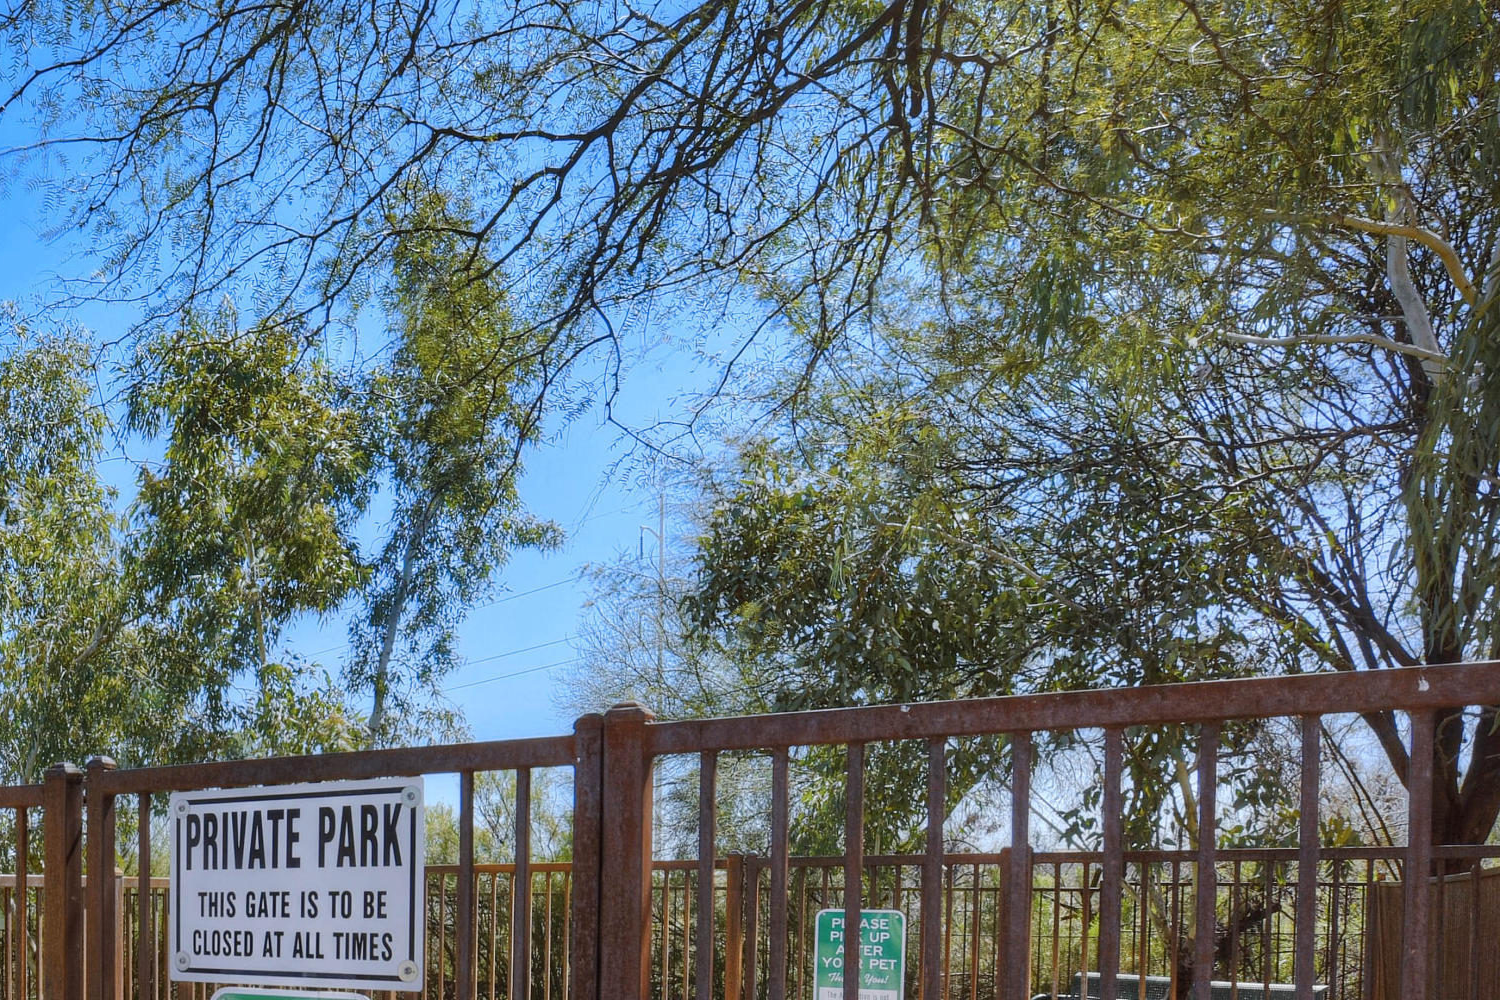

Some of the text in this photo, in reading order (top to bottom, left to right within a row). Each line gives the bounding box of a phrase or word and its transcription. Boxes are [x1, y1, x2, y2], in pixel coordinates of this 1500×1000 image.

[186, 803, 403, 870] PRIVATE PARK
[198, 890, 388, 919] THIS GATE IS TO BE
[831, 918, 889, 930] PASE
[193, 930, 393, 961] CLOSED AT ALL TIMES
[869, 932, 890, 943] UP
[869, 959, 897, 970] PET
